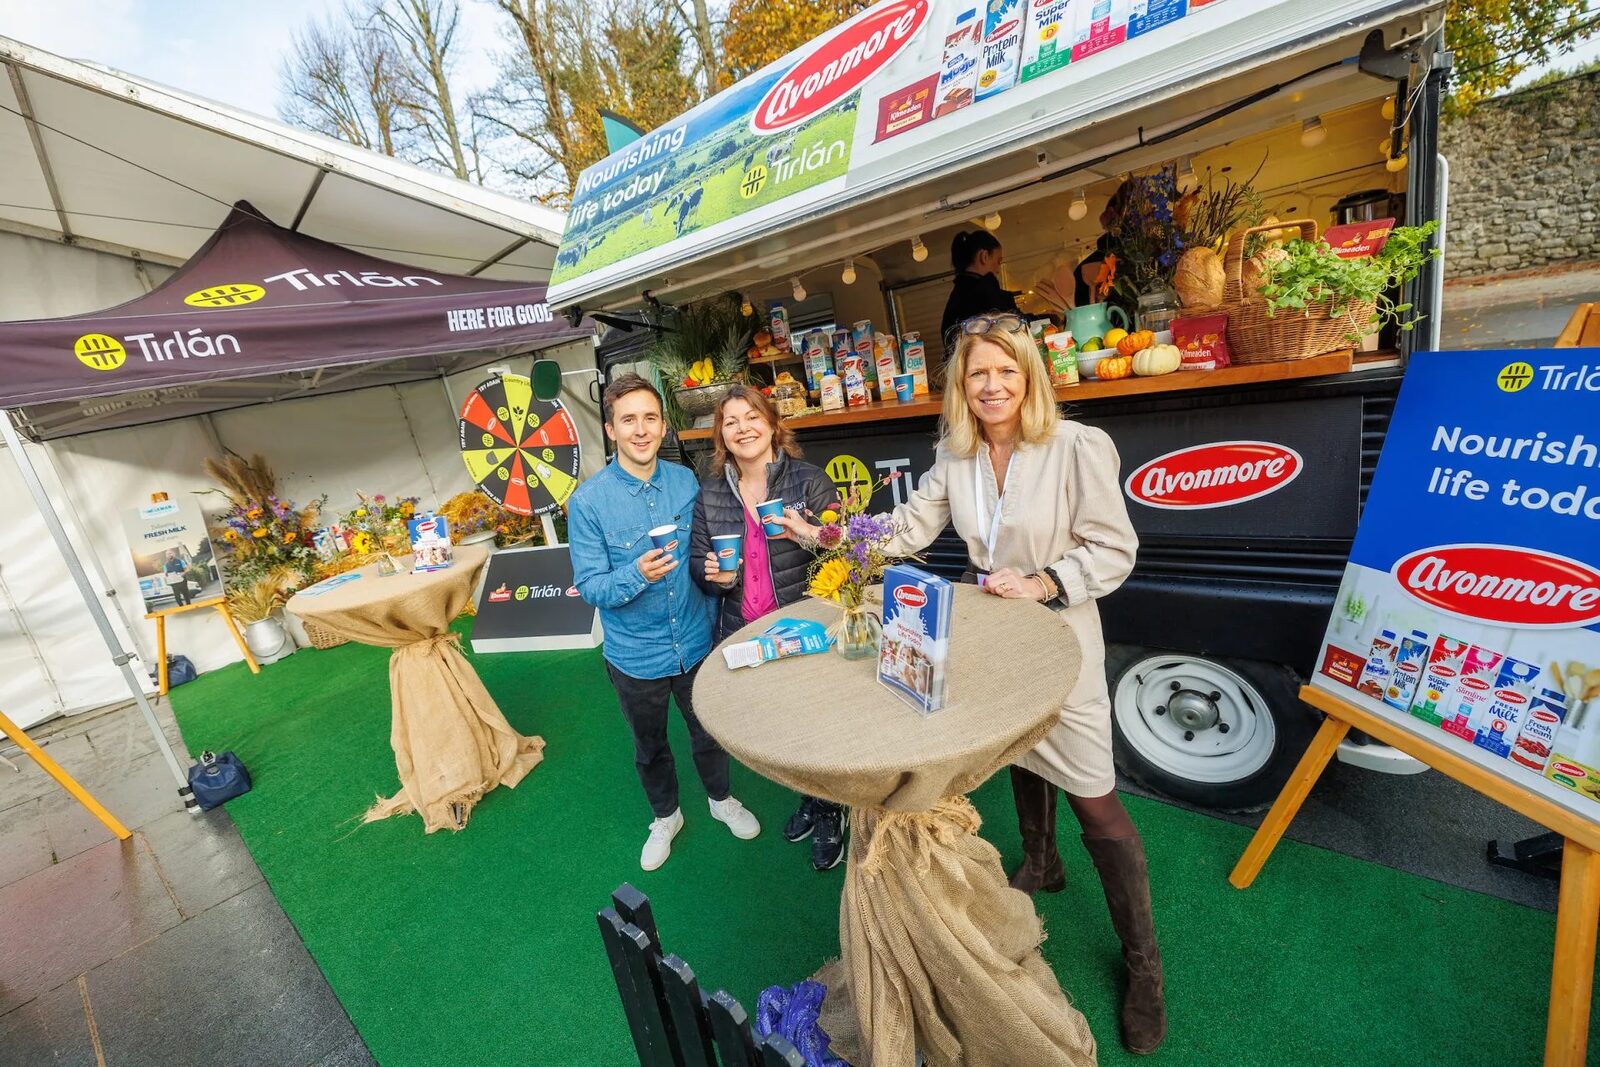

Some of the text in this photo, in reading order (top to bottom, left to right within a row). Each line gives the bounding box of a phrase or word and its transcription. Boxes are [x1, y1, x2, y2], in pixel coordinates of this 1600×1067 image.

[1039, 12, 1063, 29] Milk
[982, 34, 1017, 58] Protein
[986, 50, 1006, 70] Milk
[578, 124, 688, 195] Nourishing
[771, 139, 845, 184] Tirlán
[569, 167, 667, 228] life today
[447, 308, 487, 332] HERE
[486, 305, 516, 328] FOR
[124, 327, 241, 362] Tirlán
[488, 379, 500, 388] AGAIN
[1431, 426, 1600, 468] Nourish
[1427, 467, 1490, 501] life
[144, 530, 168, 540] FRESH
[168, 525, 187, 535] MILK
[530, 584, 561, 599] Tirlán
[1393, 668, 1416, 685] Protein
[1393, 678, 1408, 690] Milk
[1427, 675, 1451, 688] Super
[1428, 683, 1445, 694] Milk
[1456, 686, 1487, 703] Slimline
[1489, 705, 1518, 723] Milk
[1494, 700, 1519, 712] FRESH
[1525, 725, 1553, 741] Cream
[1528, 719, 1552, 733] Fresh
